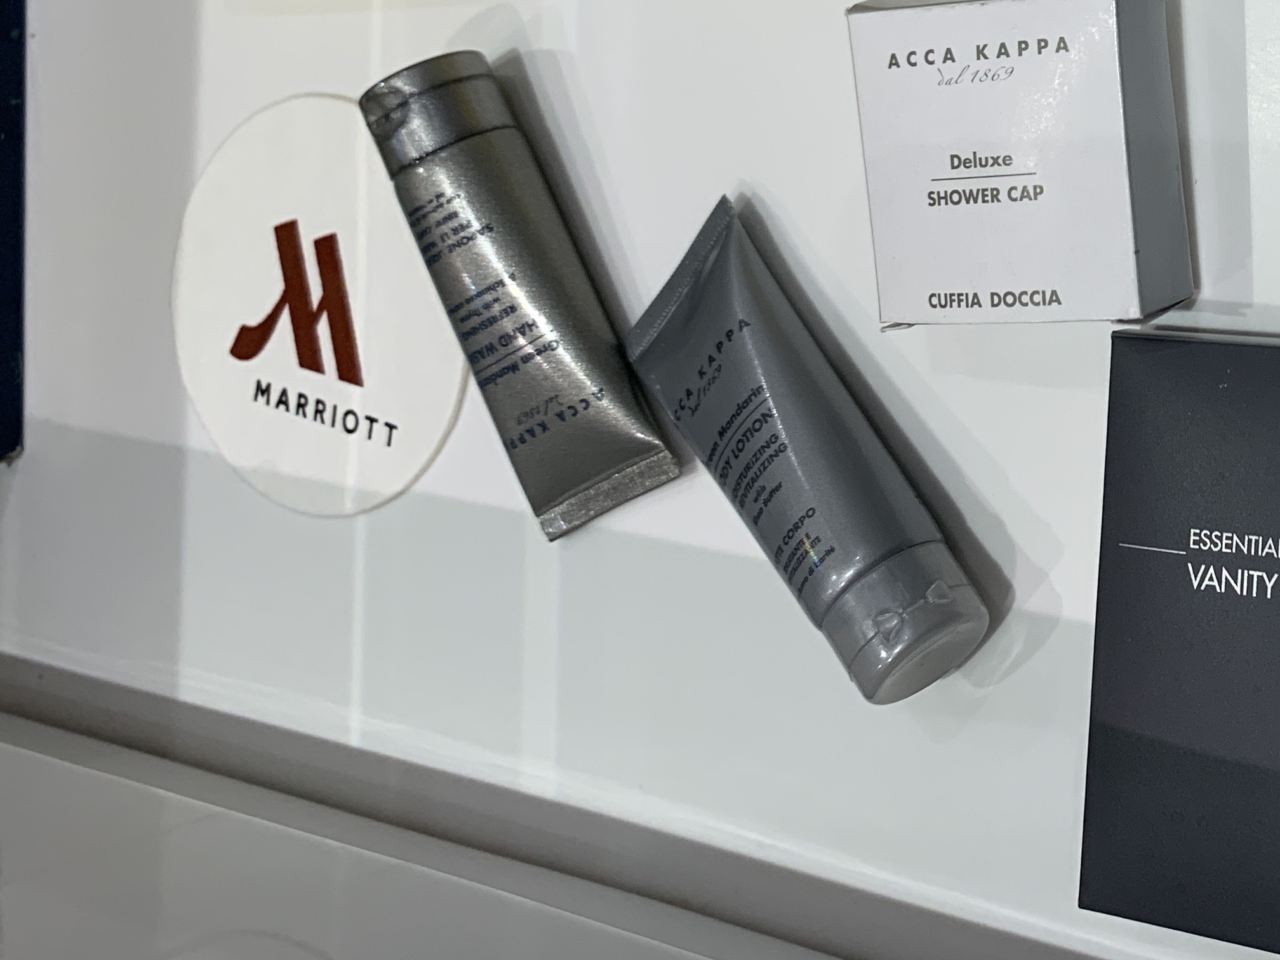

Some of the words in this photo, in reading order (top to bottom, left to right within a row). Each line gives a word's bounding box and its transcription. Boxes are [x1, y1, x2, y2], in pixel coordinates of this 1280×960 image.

[888, 47, 956, 70] ACCA
[976, 36, 1070, 61] KAPPA
[969, 66, 1015, 84] 1869
[950, 151, 1013, 170] Deluxe
[927, 187, 1001, 207] SHOWER
[1007, 184, 1045, 203] CAP
[928, 292, 982, 309] CUFFIA
[990, 289, 1062, 308] DOCCIA
[499, 318, 539, 348] HAND
[467, 342, 498, 365] WAS
[674, 388, 694, 421] CCA
[698, 318, 751, 379] KAPPA
[253, 378, 398, 447] MARRIOTT
[717, 384, 765, 442] Mandarin
[719, 455, 733, 487] ODY
[731, 406, 776, 460] LOTION
[732, 433, 779, 500] OISTURIZING
[783, 506, 816, 546] CORPO
[1187, 562, 1279, 600] VANITY
